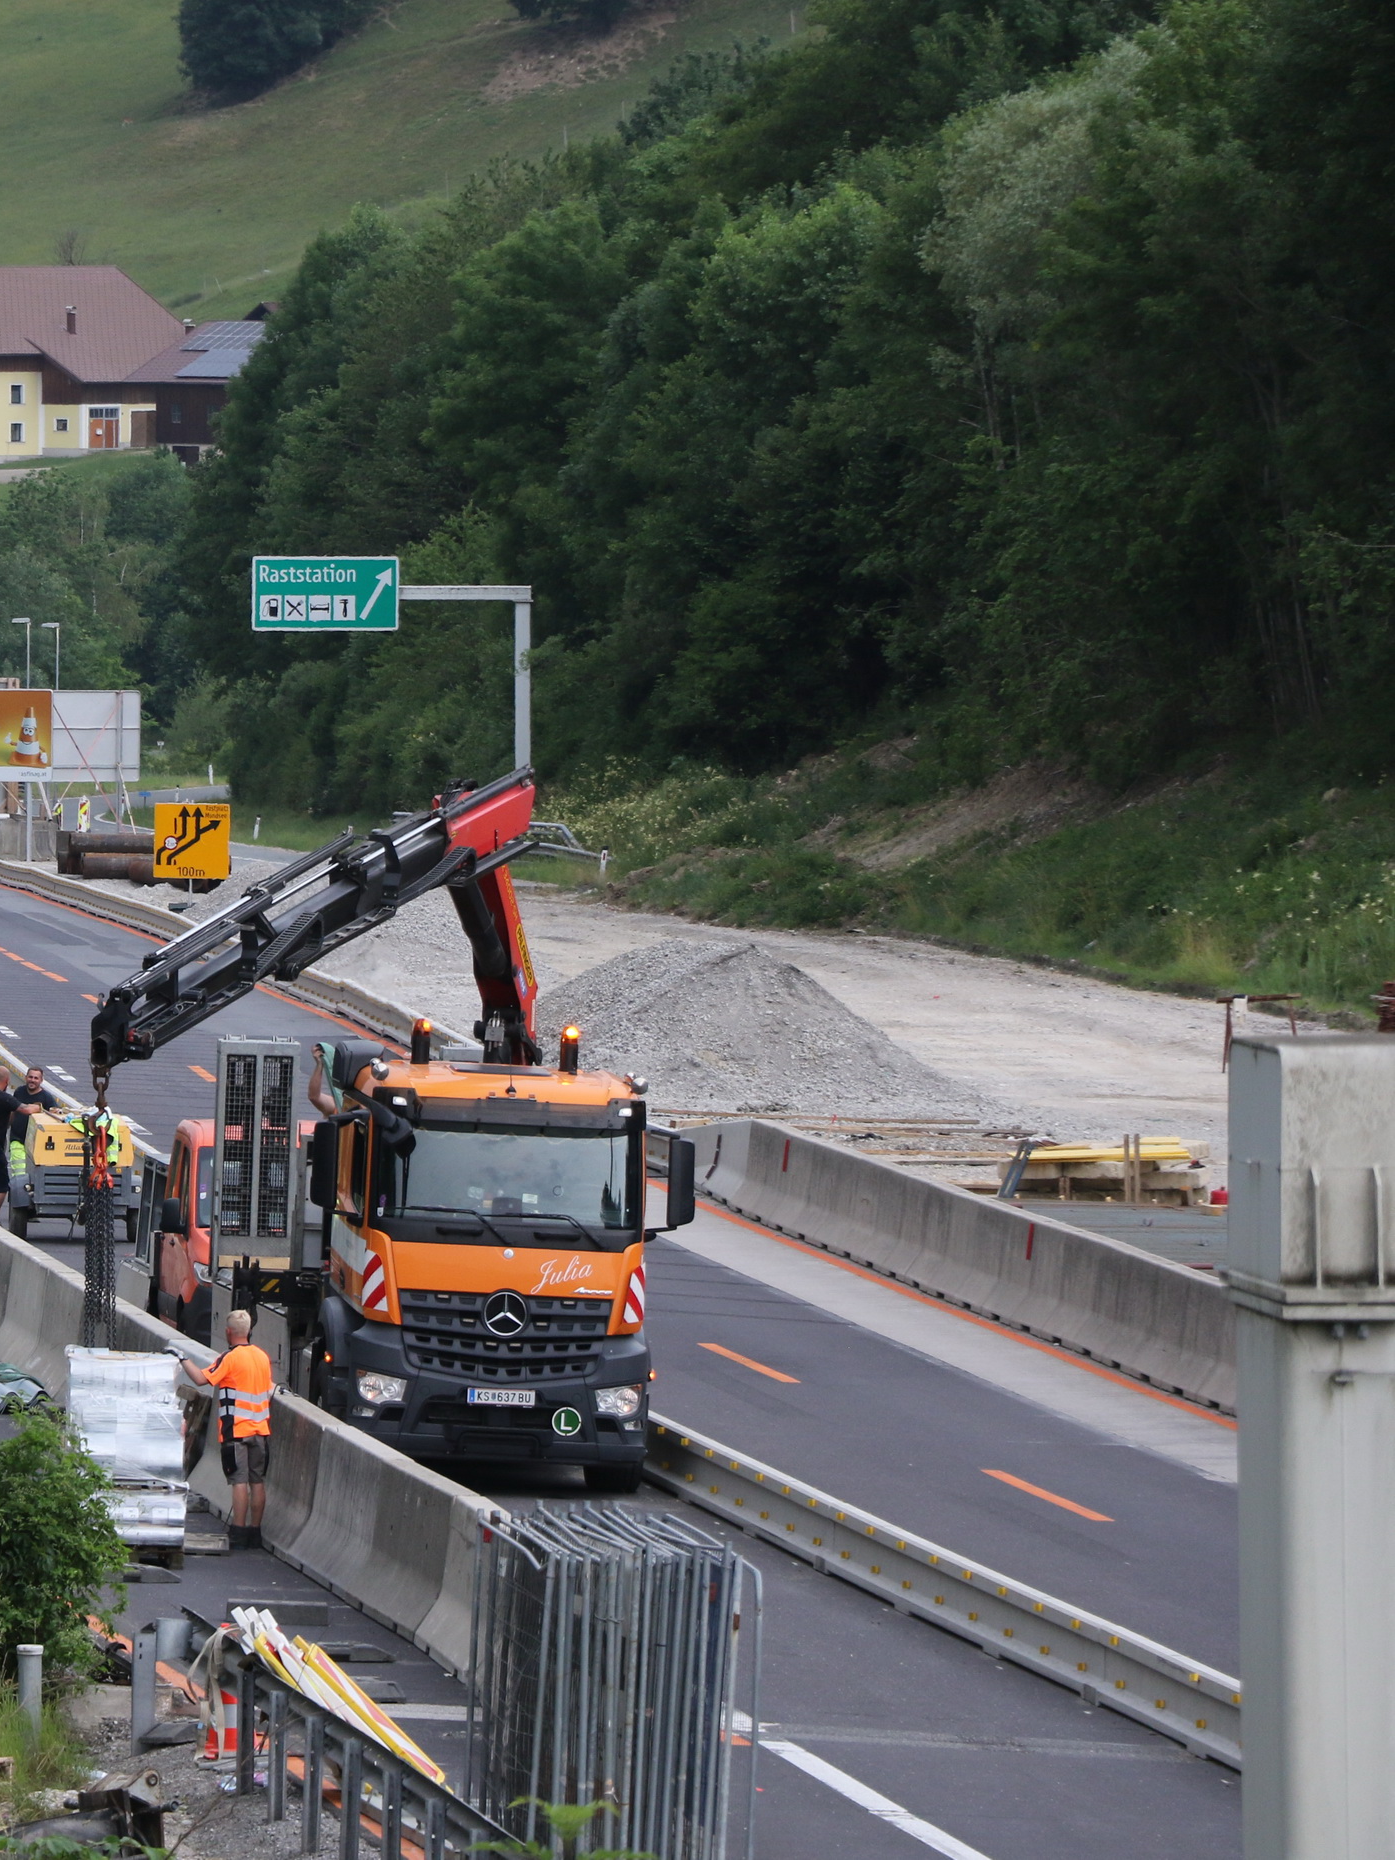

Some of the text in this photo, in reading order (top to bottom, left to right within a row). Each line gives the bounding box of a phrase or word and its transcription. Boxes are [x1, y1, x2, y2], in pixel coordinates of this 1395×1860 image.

[259, 563, 356, 583] Raststation
[177, 866, 206, 877] 100m
[530, 1255, 593, 1295] Julia
[477, 1390, 490, 1402] KS
[560, 1412, 573, 1431] L
